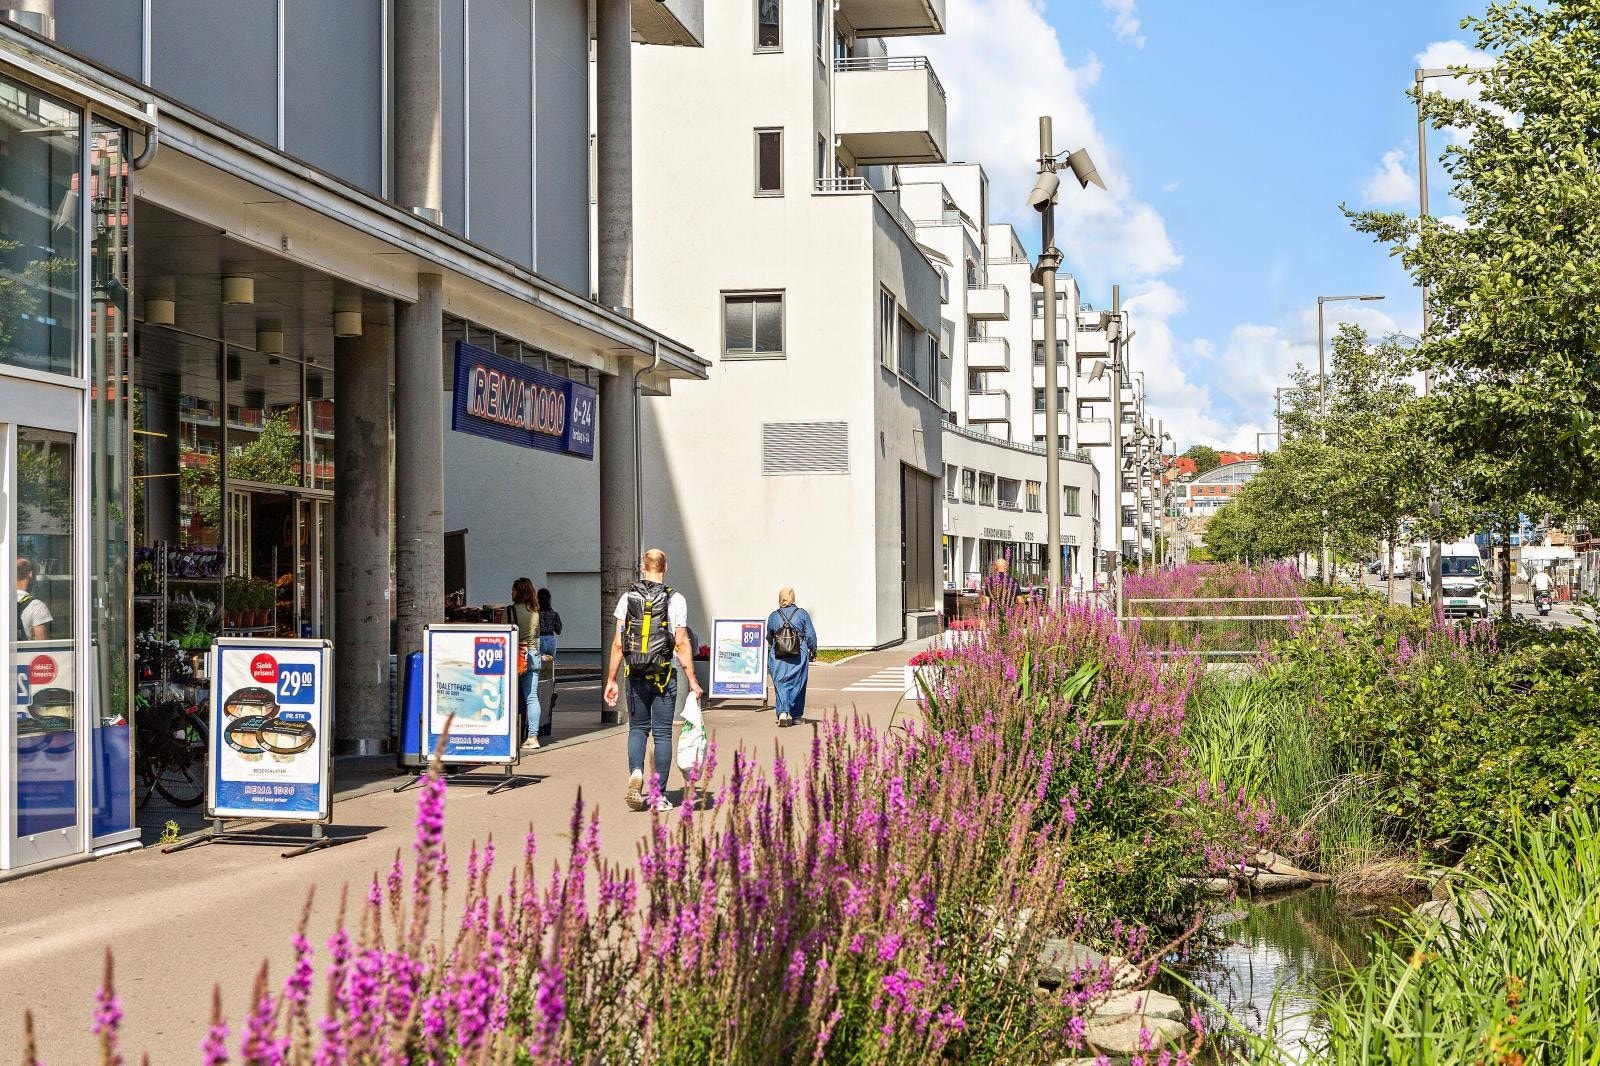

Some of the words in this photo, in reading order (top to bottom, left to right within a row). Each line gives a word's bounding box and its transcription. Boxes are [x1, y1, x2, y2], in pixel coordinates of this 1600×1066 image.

[473, 363, 526, 427] REMA
[529, 384, 566, 436] 1000
[573, 397, 592, 426] 6-24
[744, 631, 753, 643] 89
[256, 662, 272, 670] Sjekk
[477, 649, 494, 668] 89
[494, 650, 503, 658] 00
[280, 671, 300, 697] 29
[301, 672, 312, 684] 00
[244, 785, 272, 795] REMA
[273, 786, 295, 796] 1000
